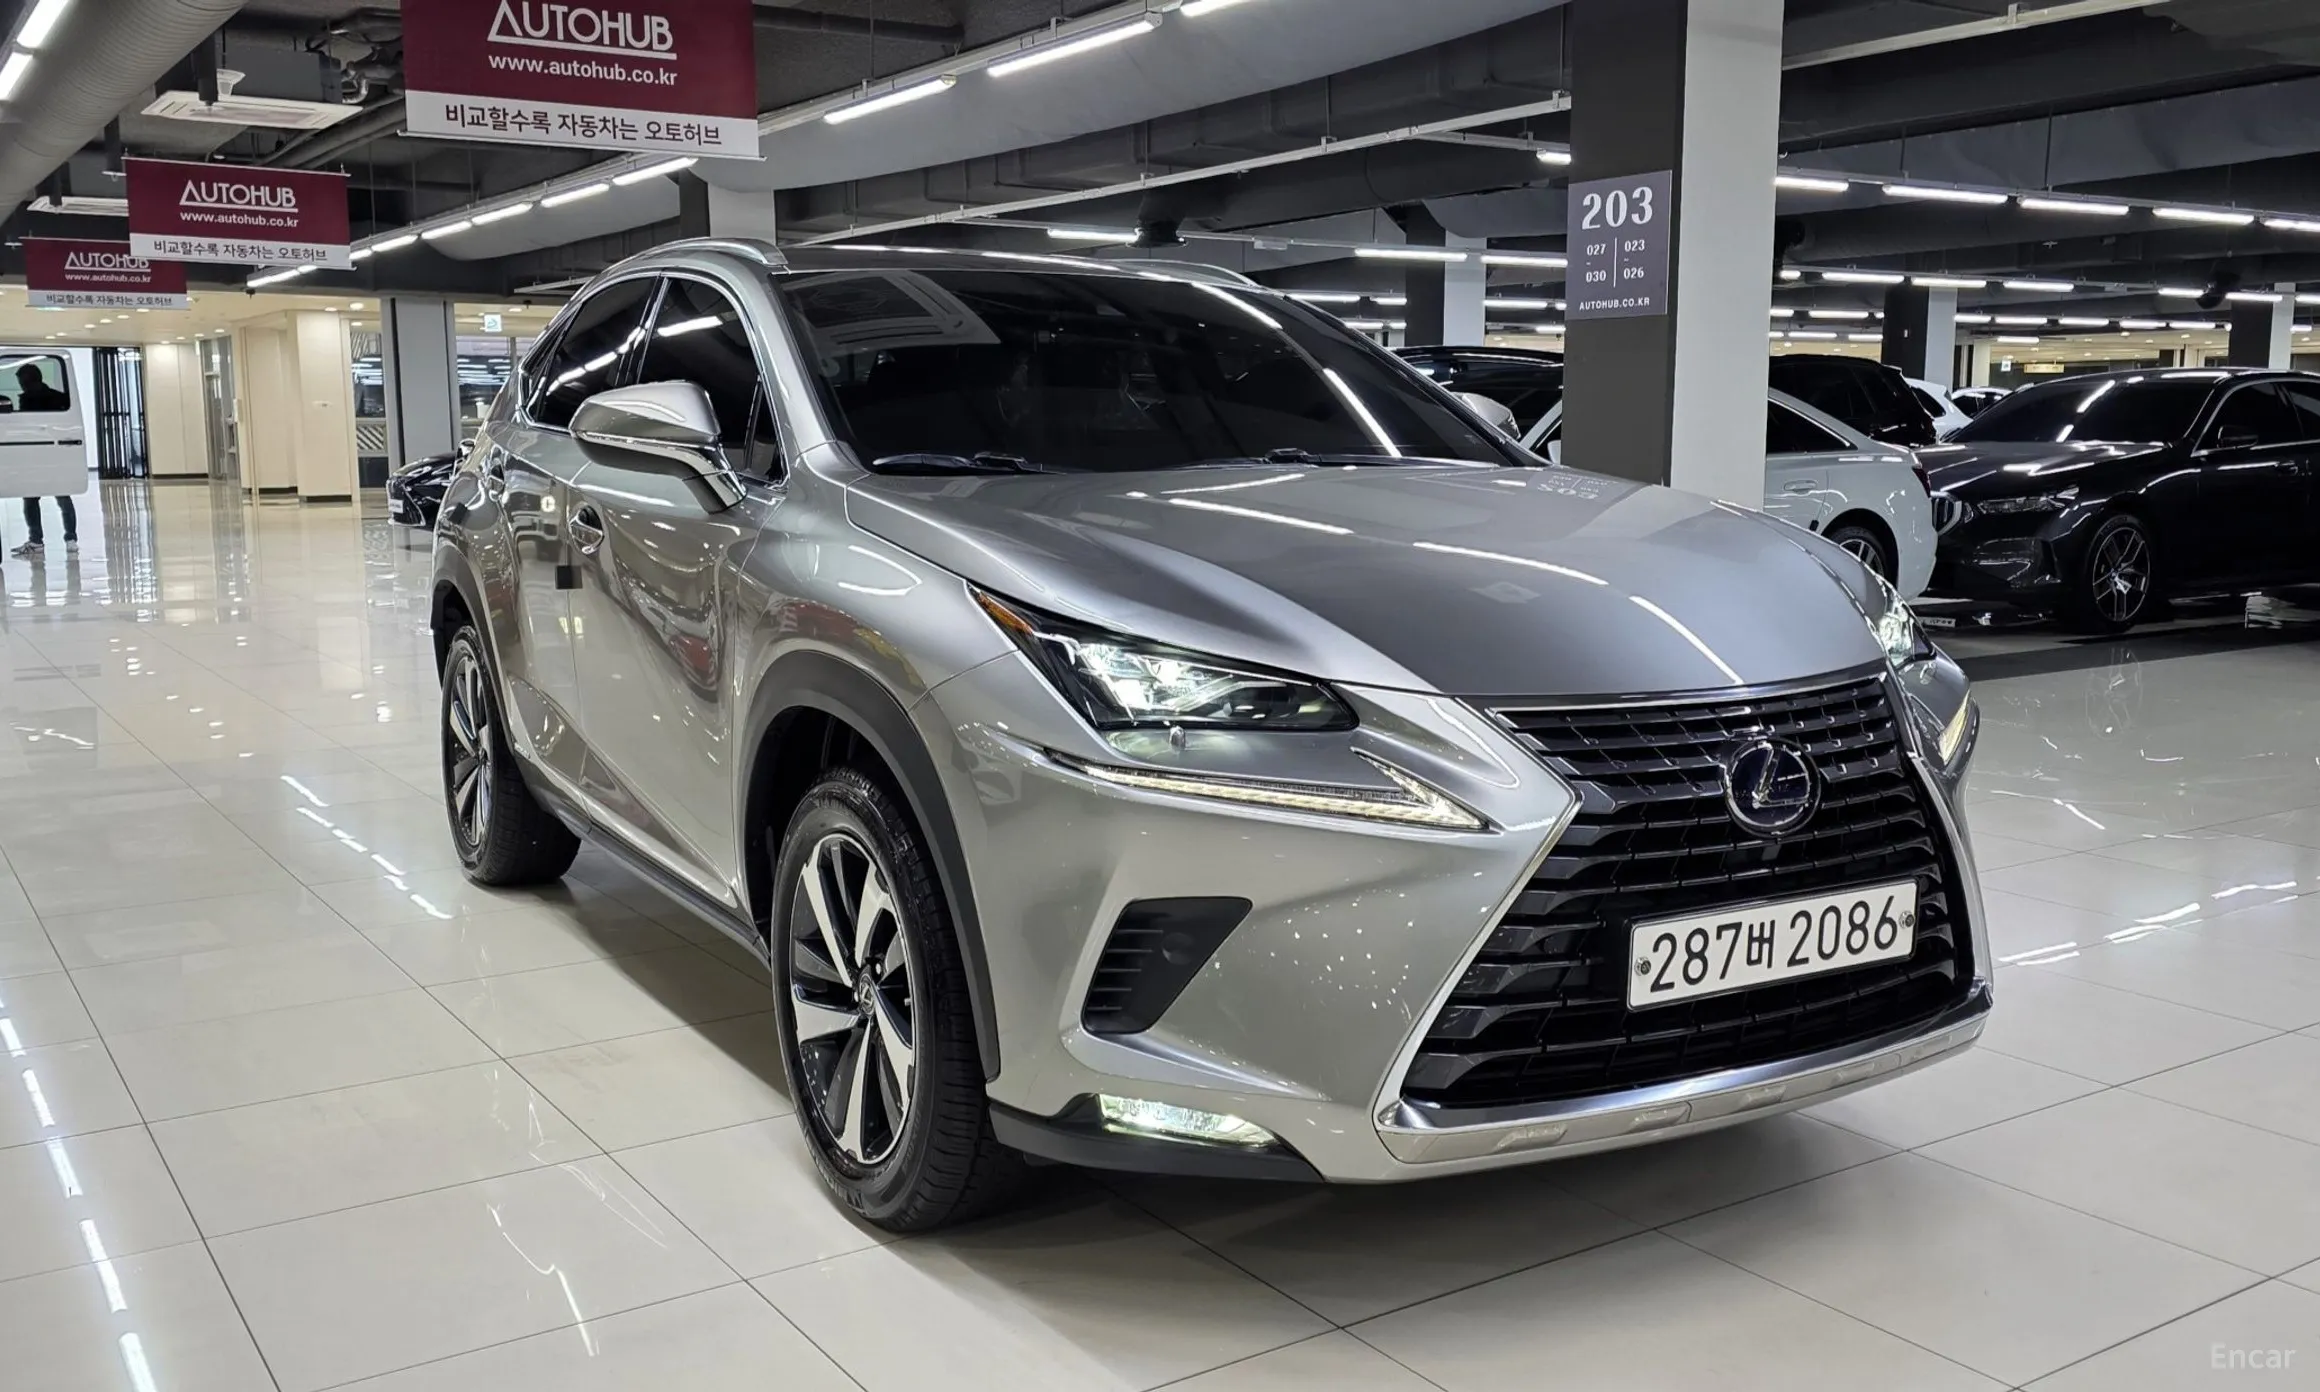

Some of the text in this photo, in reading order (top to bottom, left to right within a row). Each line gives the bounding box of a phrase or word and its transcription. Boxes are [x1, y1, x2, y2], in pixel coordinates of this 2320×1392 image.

[487, 0, 675, 56] AUTOHUB
[488, 54, 678, 87] www.autohub.co.kr
[445, 103, 722, 146] 비교할수록 자동차는 오토허브
[179, 180, 297, 209] AUTOHUB
[1581, 186, 1653, 230] 203
[180, 211, 299, 228] www.autohub.co.kr
[153, 240, 328, 261] 비교할수록 자동차는 오토허브
[1586, 243, 1606, 256] 027
[1624, 239, 1646, 252] 023
[1585, 269, 1607, 283] 030
[1623, 266, 1645, 280] 026
[1579, 296, 1650, 311] AUTOHUB.CO.KR
[1649, 895, 1898, 993] 287버 2086
